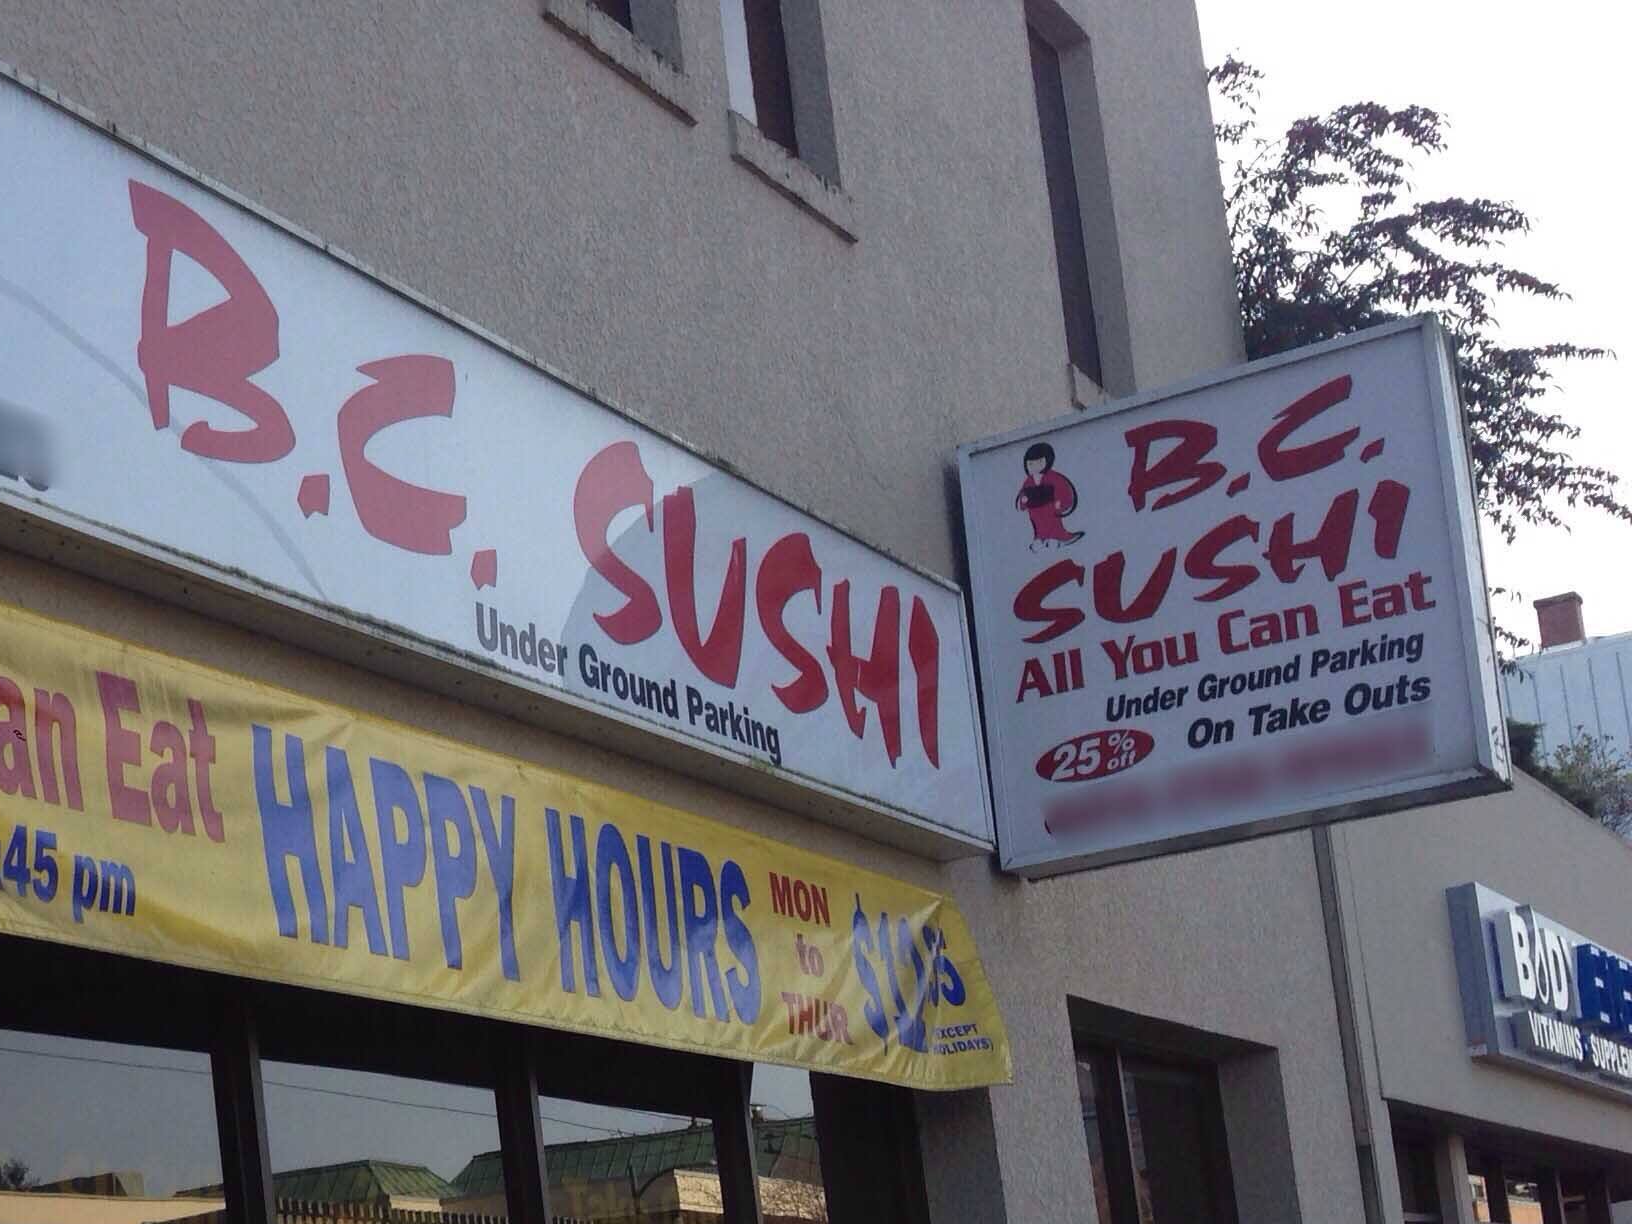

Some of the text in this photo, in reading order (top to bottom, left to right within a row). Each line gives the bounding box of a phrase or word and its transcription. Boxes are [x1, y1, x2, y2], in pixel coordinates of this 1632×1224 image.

[129, 178, 498, 590] B.C.
[573, 441, 941, 770] SUSHI
[1125, 374, 1384, 514] B.C.
[1013, 479, 1410, 644] SUSHI
[1015, 571, 1437, 704] All You Can Eat
[1105, 632, 1424, 722] Under Ground Parking
[474, 602, 782, 766] Under Ground Parking
[1187, 675, 1431, 750] On Take Outs
[1107, 750, 1136, 770] off
[72, 852, 136, 924] pm
[96, 670, 225, 844] Eat
[251, 724, 521, 981] HAPPY
[545, 807, 762, 1027] HOURS
[769, 872, 830, 928] MON
[796, 933, 824, 977] to
[781, 991, 855, 1045] THUR
[1528, 1010, 1584, 1062] VITAMINS
